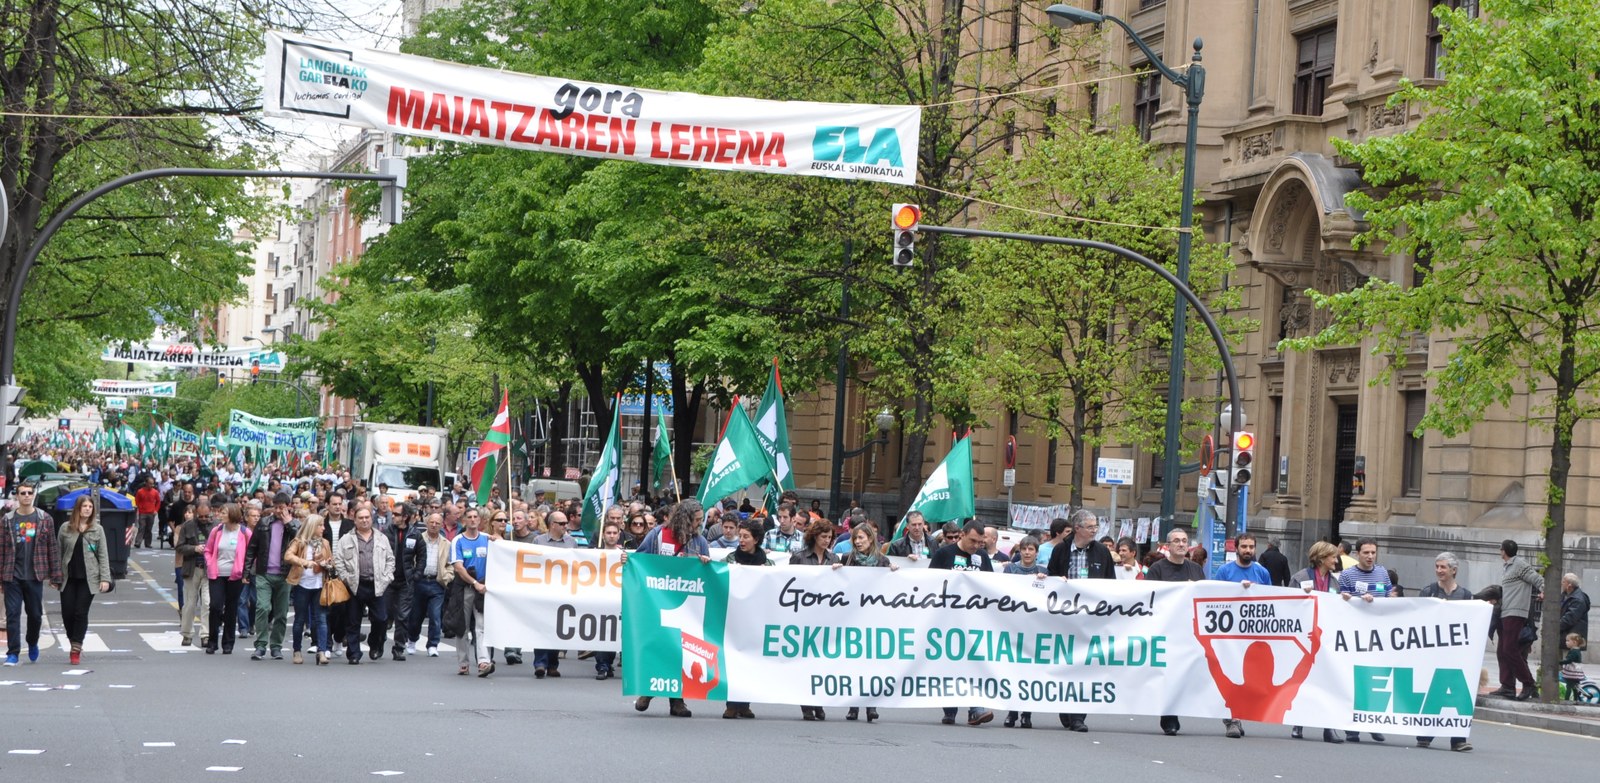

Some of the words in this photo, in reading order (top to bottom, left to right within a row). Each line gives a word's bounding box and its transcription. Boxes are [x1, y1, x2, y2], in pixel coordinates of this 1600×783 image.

[300, 57, 367, 78] LANGILEAK
[294, 92, 330, 101] luchamos
[551, 83, 643, 120] gora
[387, 85, 639, 155] MAIATZAREN
[650, 121, 787, 167] LEHENA
[812, 126, 903, 167] ELA
[811, 162, 847, 172] EUSKAL
[849, 165, 903, 177] SINDIKATUA
[114, 348, 193, 363] MAIATZAREN
[198, 354, 243, 366] LEHENA
[165, 345, 193, 356] gora
[233, 412, 244, 422] EZ
[515, 549, 622, 595] Enple
[646, 575, 704, 593] maiatzak
[779, 577, 850, 613] Gora
[860, 580, 1037, 614] maiatzaren
[1046, 586, 1155, 618] lehena!
[1204, 610, 1234, 633] 30
[1240, 604, 1275, 618] GREBA
[1238, 619, 1302, 633] OROKORRA
[681, 637, 714, 660] Lankidetu!
[762, 624, 915, 660] ESKUBIDE
[925, 627, 1074, 666] SOZIALEN
[1085, 635, 1167, 668] ALDE
[1335, 630, 1348, 652] A
[1355, 629, 1384, 652] LA
[1390, 623, 1469, 650] CALLE!
[650, 677, 679, 692] 2013
[811, 674, 852, 696] POR
[859, 676, 896, 697] LOS
[901, 676, 1012, 700] DERECHOS
[1018, 680, 1116, 704] SOCIALES
[1353, 665, 1474, 716] ELA
[1353, 713, 1398, 725] EUSKAL
